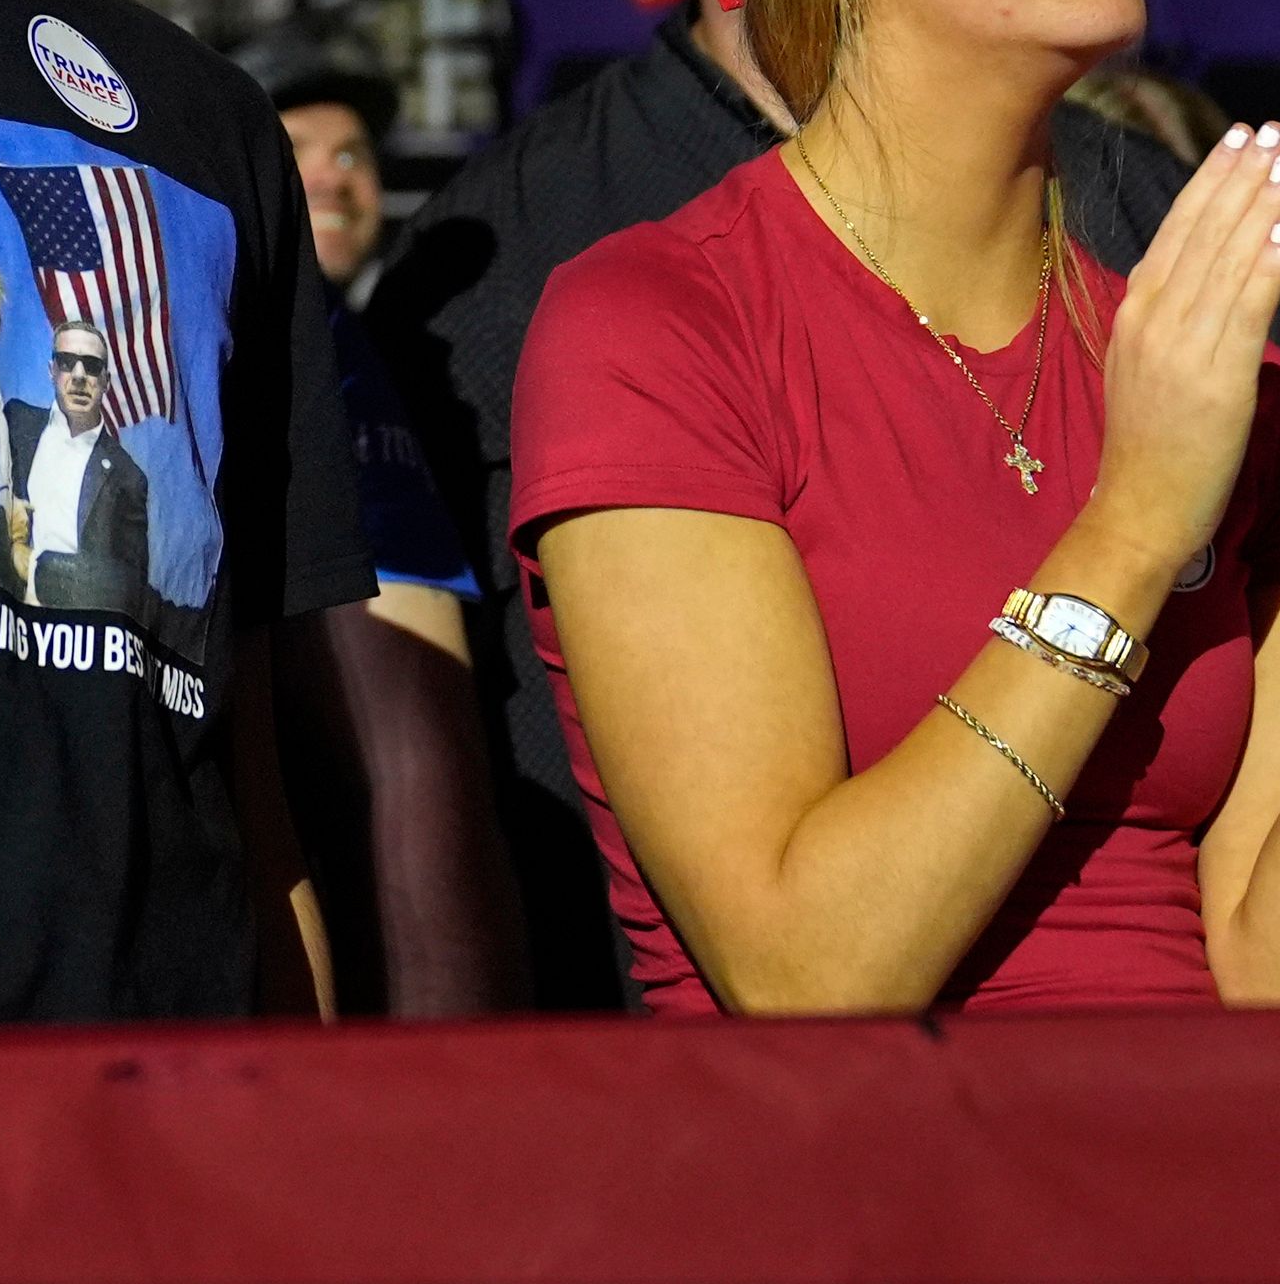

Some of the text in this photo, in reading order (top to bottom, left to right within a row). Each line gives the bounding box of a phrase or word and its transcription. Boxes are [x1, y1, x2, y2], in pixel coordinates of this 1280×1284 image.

[37, 42, 123, 93] TRUMP
[51, 64, 121, 105] VANCE
[32, 621, 96, 672] YOU
[158, 663, 205, 720] MISS
